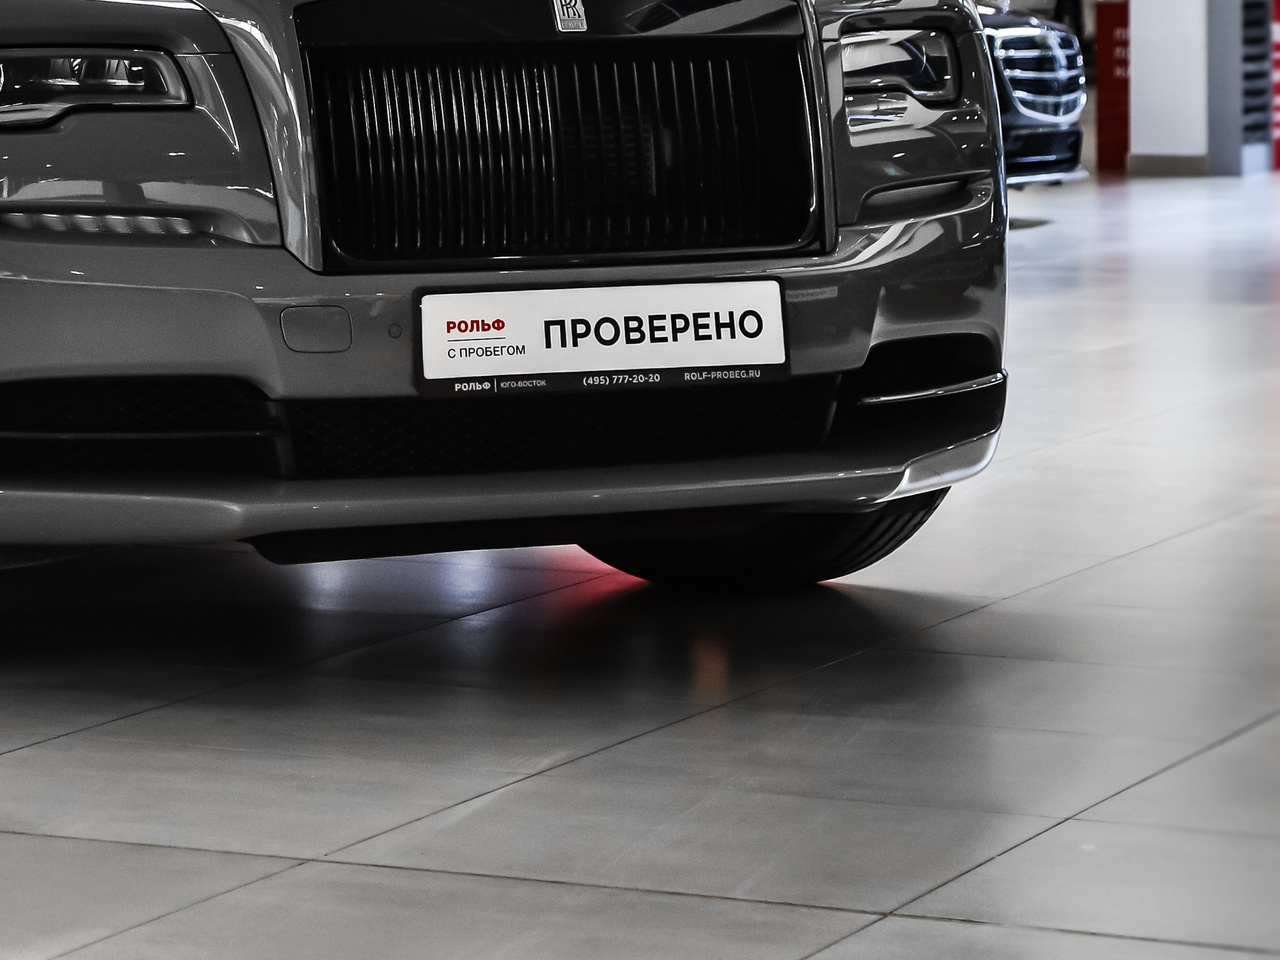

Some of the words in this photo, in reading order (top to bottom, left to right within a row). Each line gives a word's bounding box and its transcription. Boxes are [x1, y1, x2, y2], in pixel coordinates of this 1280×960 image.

[446, 319, 506, 334] РОЛЬФ
[543, 309, 764, 349] ПРОВЕРЕНО
[447, 348, 456, 359] С
[460, 345, 526, 358] ПРОБЕГОМ
[582, 376, 610, 386] (495)
[612, 373, 661, 385] 777-20-20
[684, 369, 761, 381] ROLF-PROBEG.RU
[454, 381, 491, 392] РОЛЬФ
[500, 380, 547, 389] ЮГО-ВОСТОК
